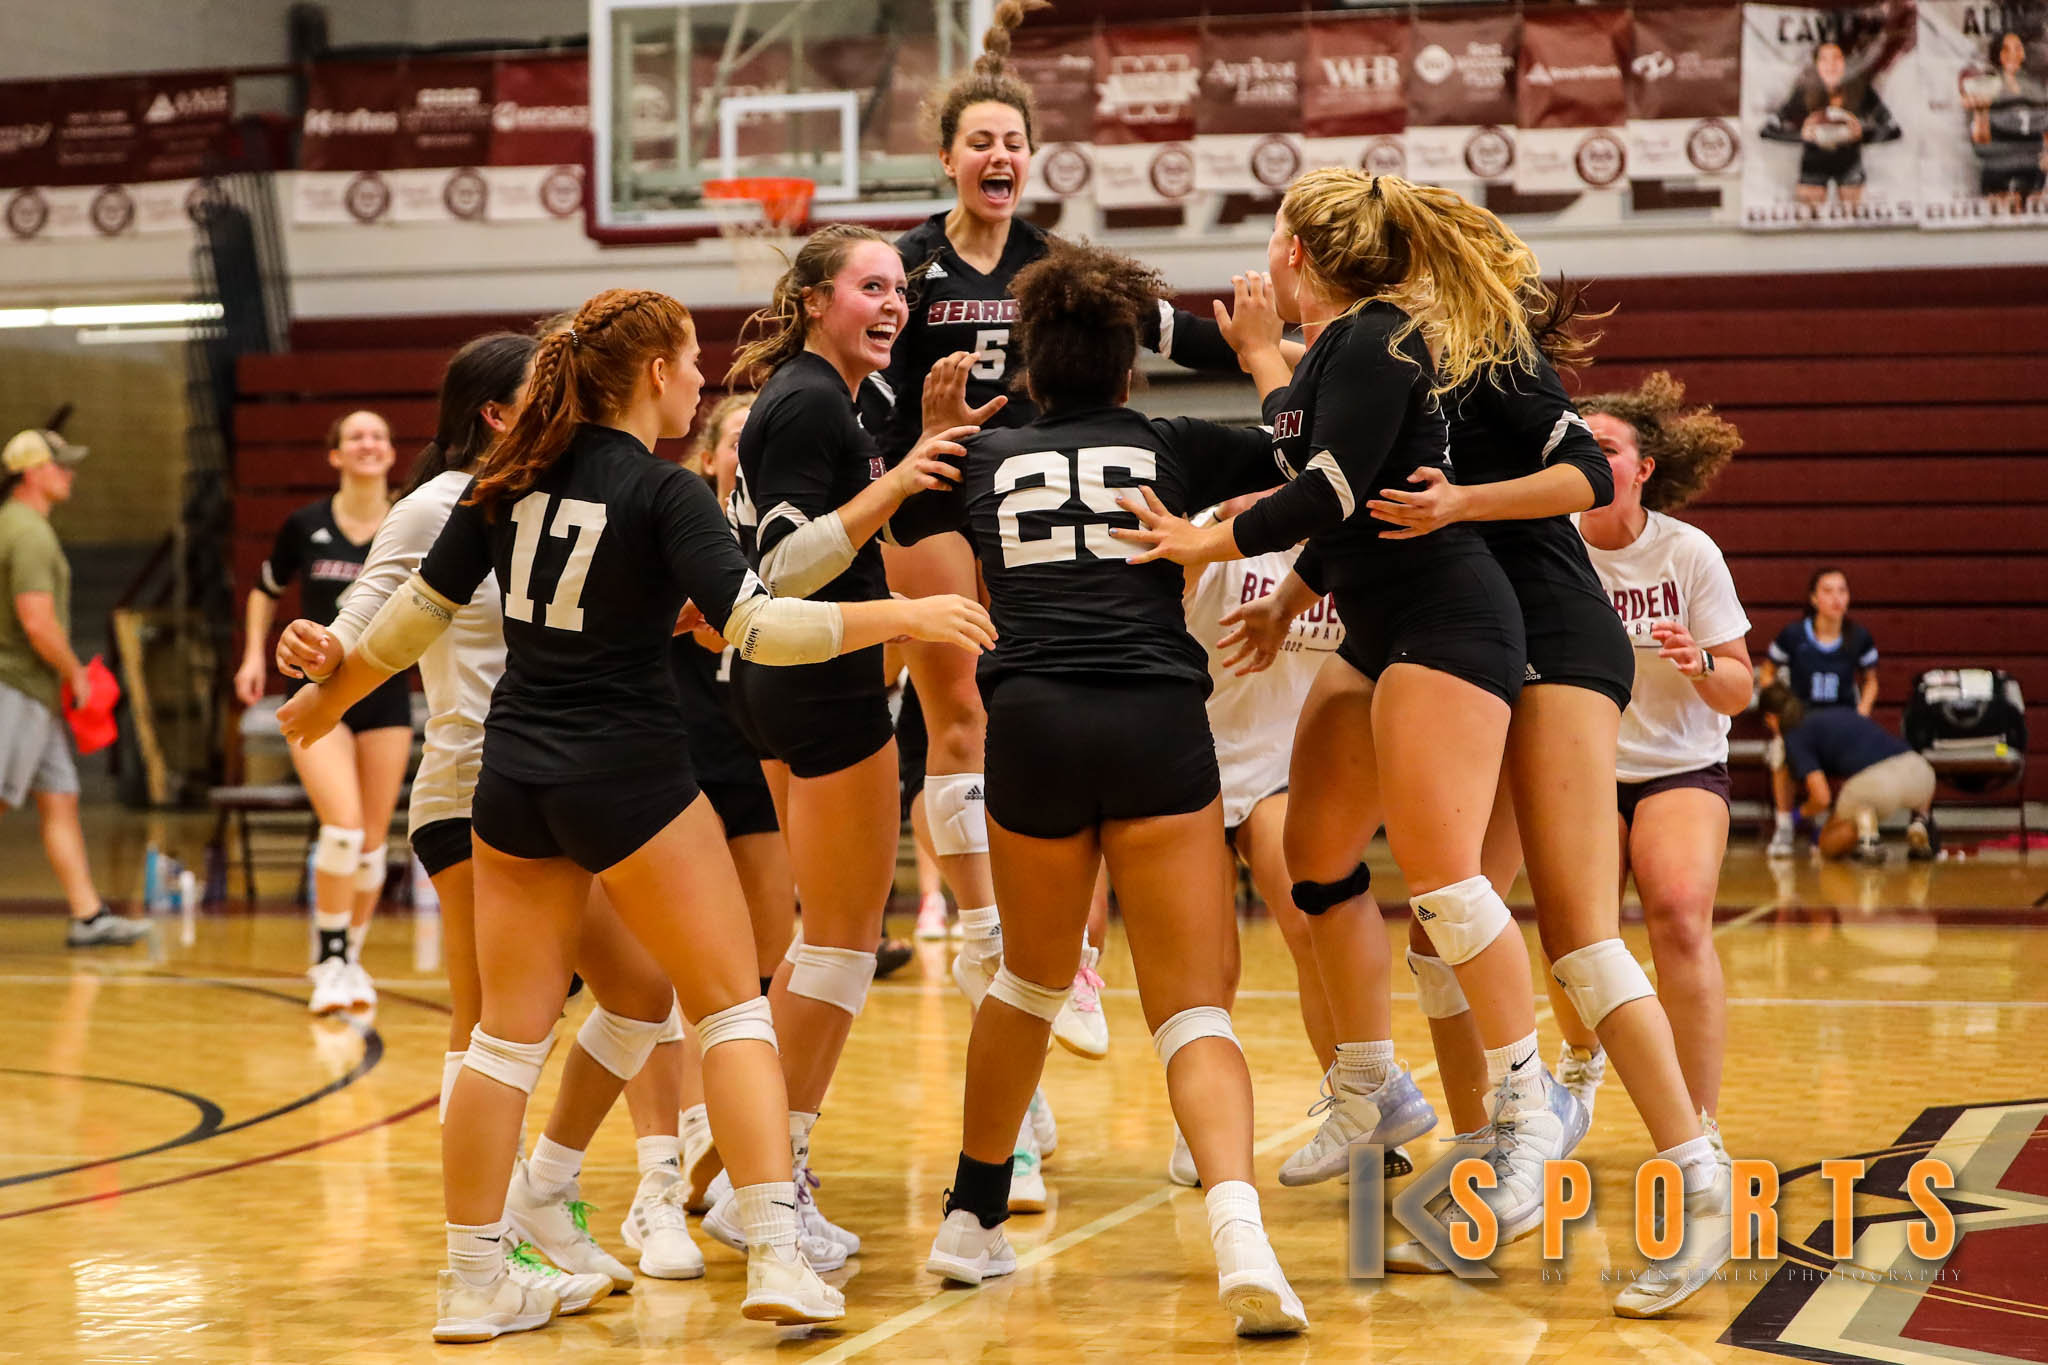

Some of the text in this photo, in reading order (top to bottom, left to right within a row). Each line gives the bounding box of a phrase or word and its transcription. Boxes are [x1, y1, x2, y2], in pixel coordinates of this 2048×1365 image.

[928, 299, 1022, 325] BEARD
[971, 329, 1009, 380] 5
[994, 446, 1157, 568] 25
[504, 491, 607, 632] 17
[1606, 580, 1680, 621] RDEN
